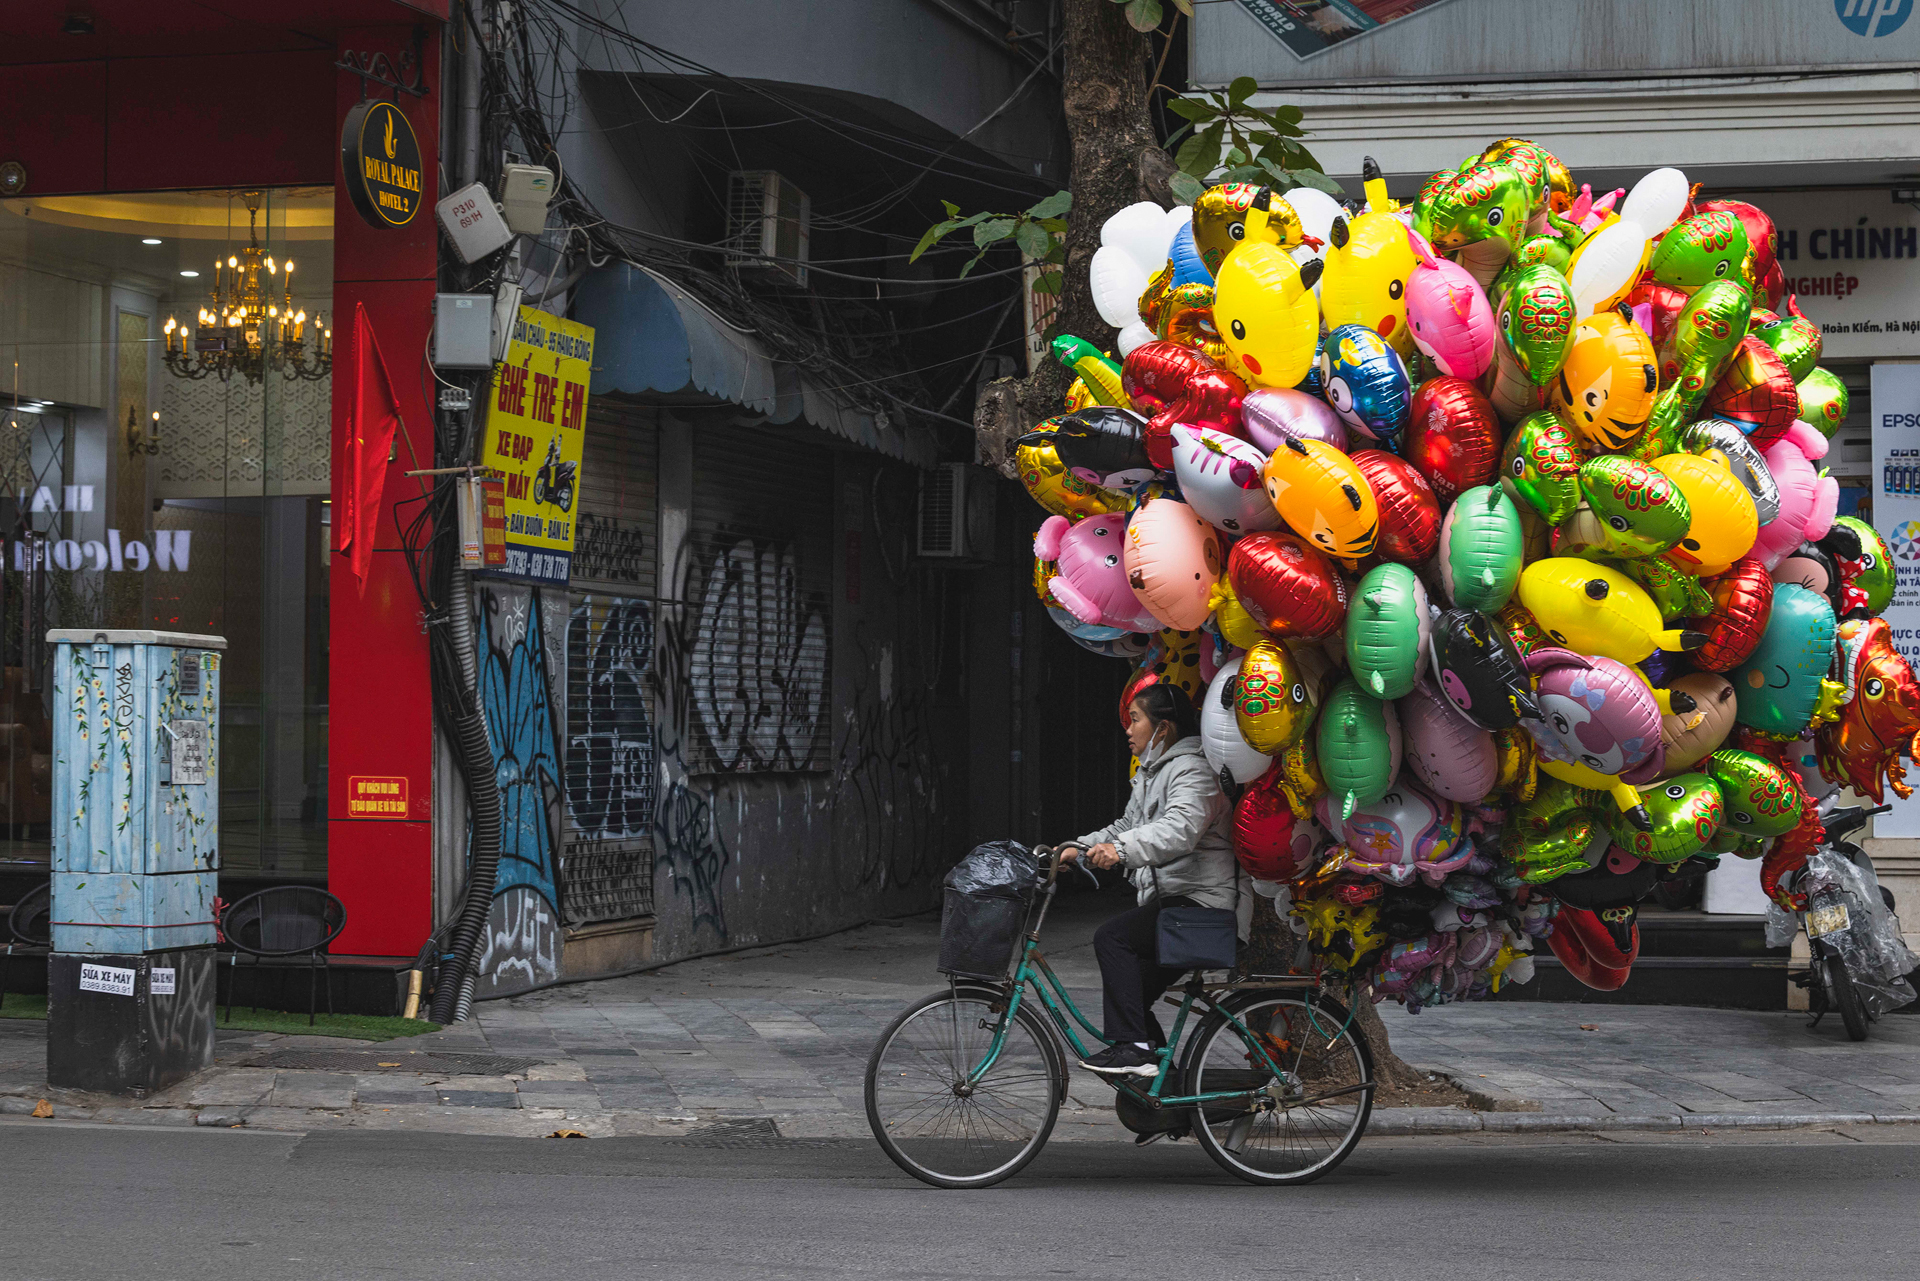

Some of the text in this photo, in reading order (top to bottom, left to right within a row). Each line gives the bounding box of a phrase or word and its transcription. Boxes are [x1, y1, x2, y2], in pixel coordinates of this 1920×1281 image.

[1249, 3, 1285, 35] TOURS
[1254, 0, 1296, 31] WORLD
[365, 155, 420, 193] ROYAL PALACE
[379, 190, 409, 212] HOTEL 2
[452, 199, 476, 217] P310
[459, 210, 483, 229] 691H
[1809, 217, 1917, 260] CHÍNH
[527, 320, 546, 349] CHÂU
[1822, 320, 1850, 334] Hoàn
[1885, 319, 1900, 333] Hà
[498, 352, 585, 431] GHẾ TRẺ EM
[496, 430, 533, 465] XE ĐẠP
[506, 470, 531, 501] MÁY
[509, 510, 525, 535] BÁN
[524, 513, 543, 538] BUÔN
[547, 516, 561, 540] BÁN
[82, 966, 132, 984] SỬA XE MÁY
